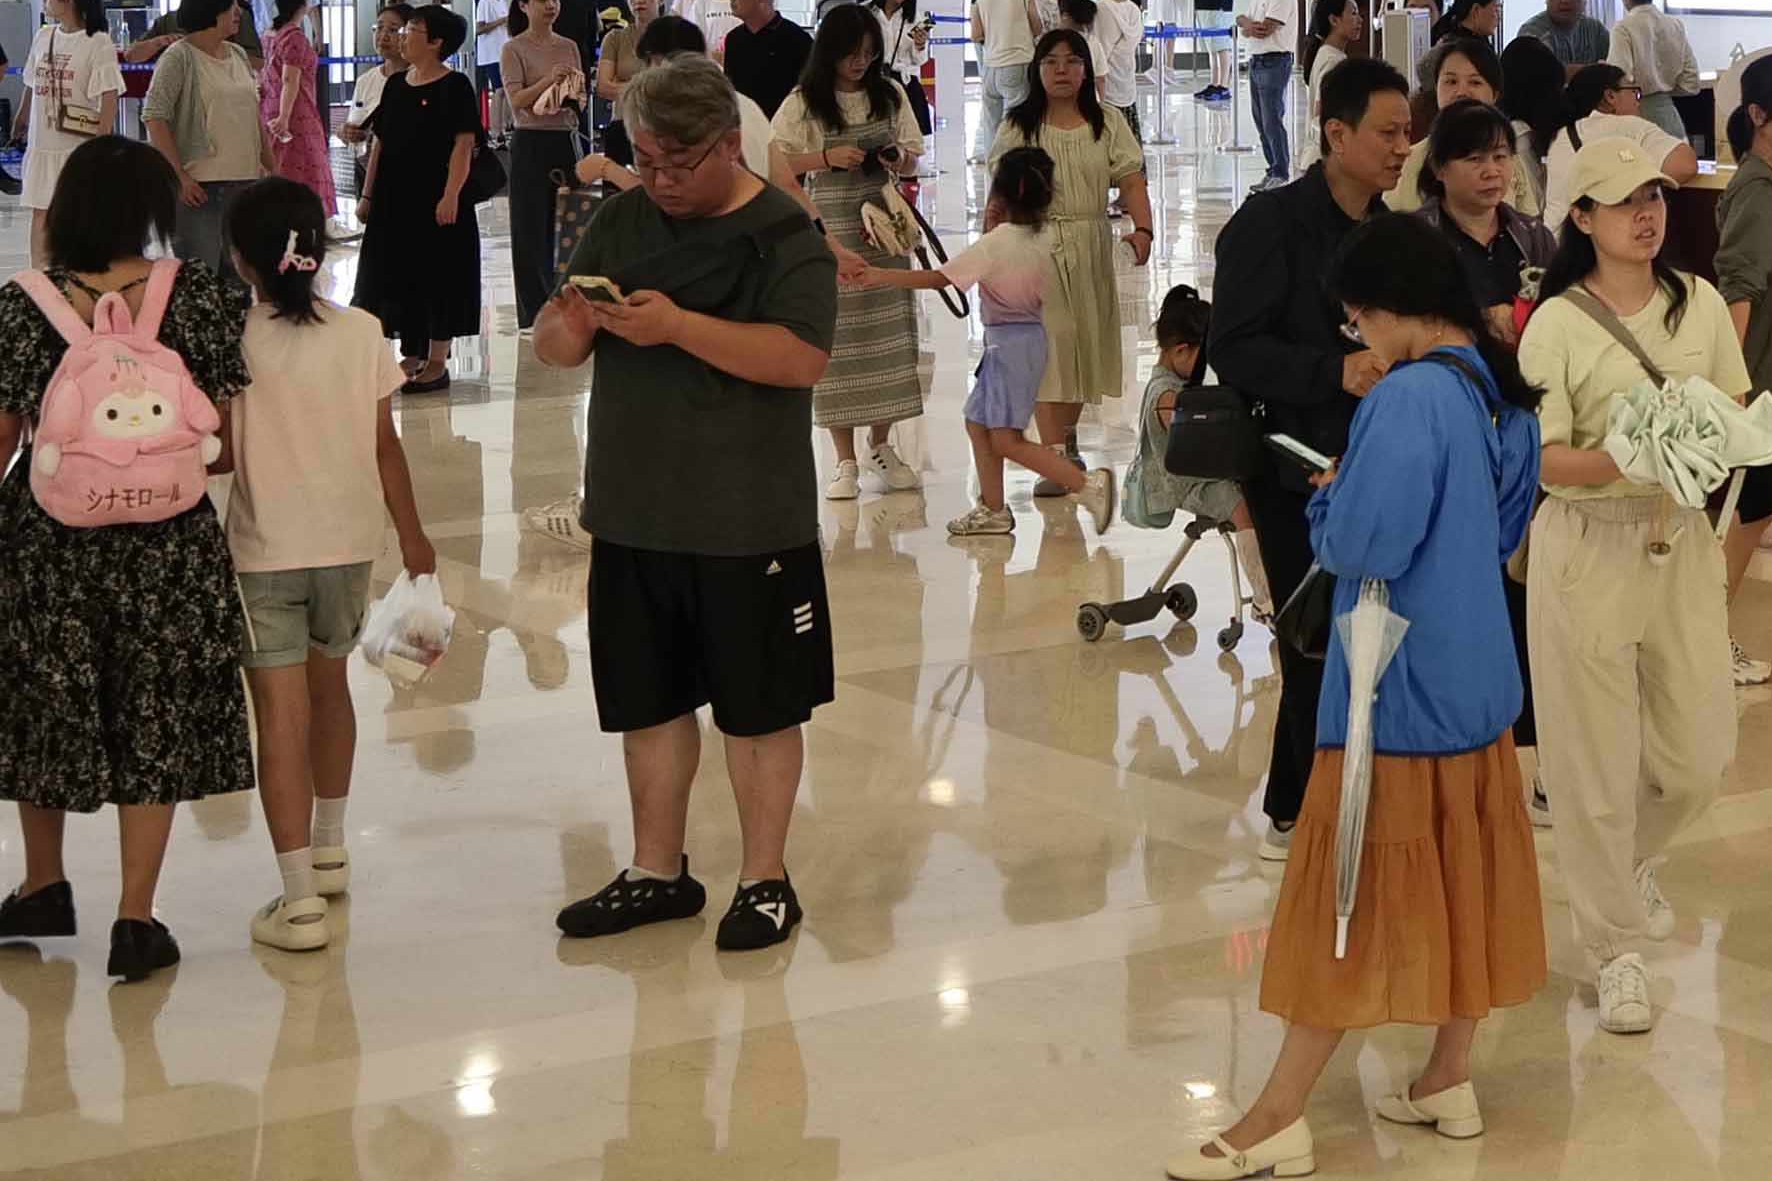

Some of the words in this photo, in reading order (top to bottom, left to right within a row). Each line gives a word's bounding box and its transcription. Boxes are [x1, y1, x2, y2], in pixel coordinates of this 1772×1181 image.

[86, 483, 181, 512] シナモロール
